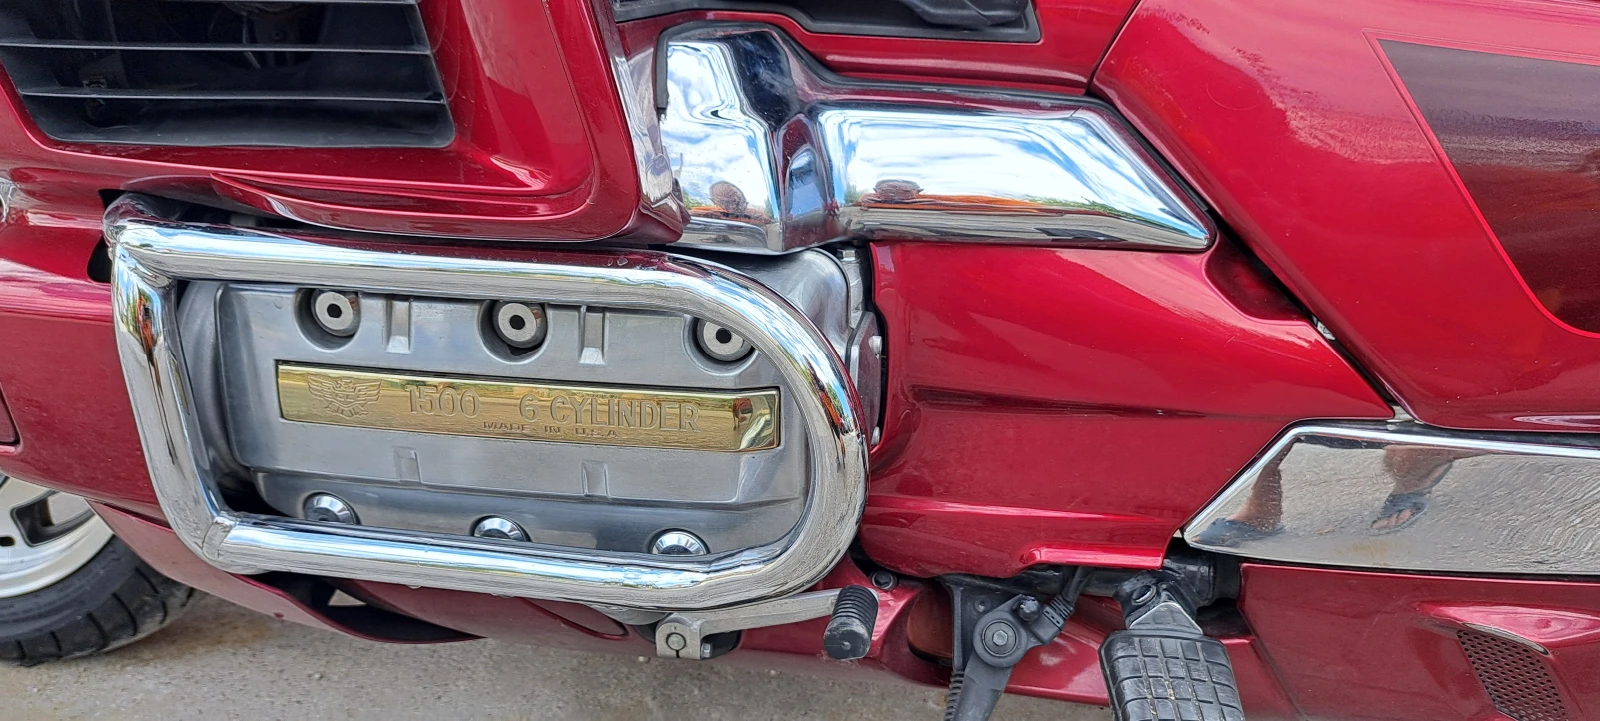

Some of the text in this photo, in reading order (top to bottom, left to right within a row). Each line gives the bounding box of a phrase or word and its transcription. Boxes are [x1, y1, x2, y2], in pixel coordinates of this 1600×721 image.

[405, 384, 700, 432] 1500 6 CYLINDER
[483, 421, 530, 432] MADE
[544, 425, 561, 434] IN
